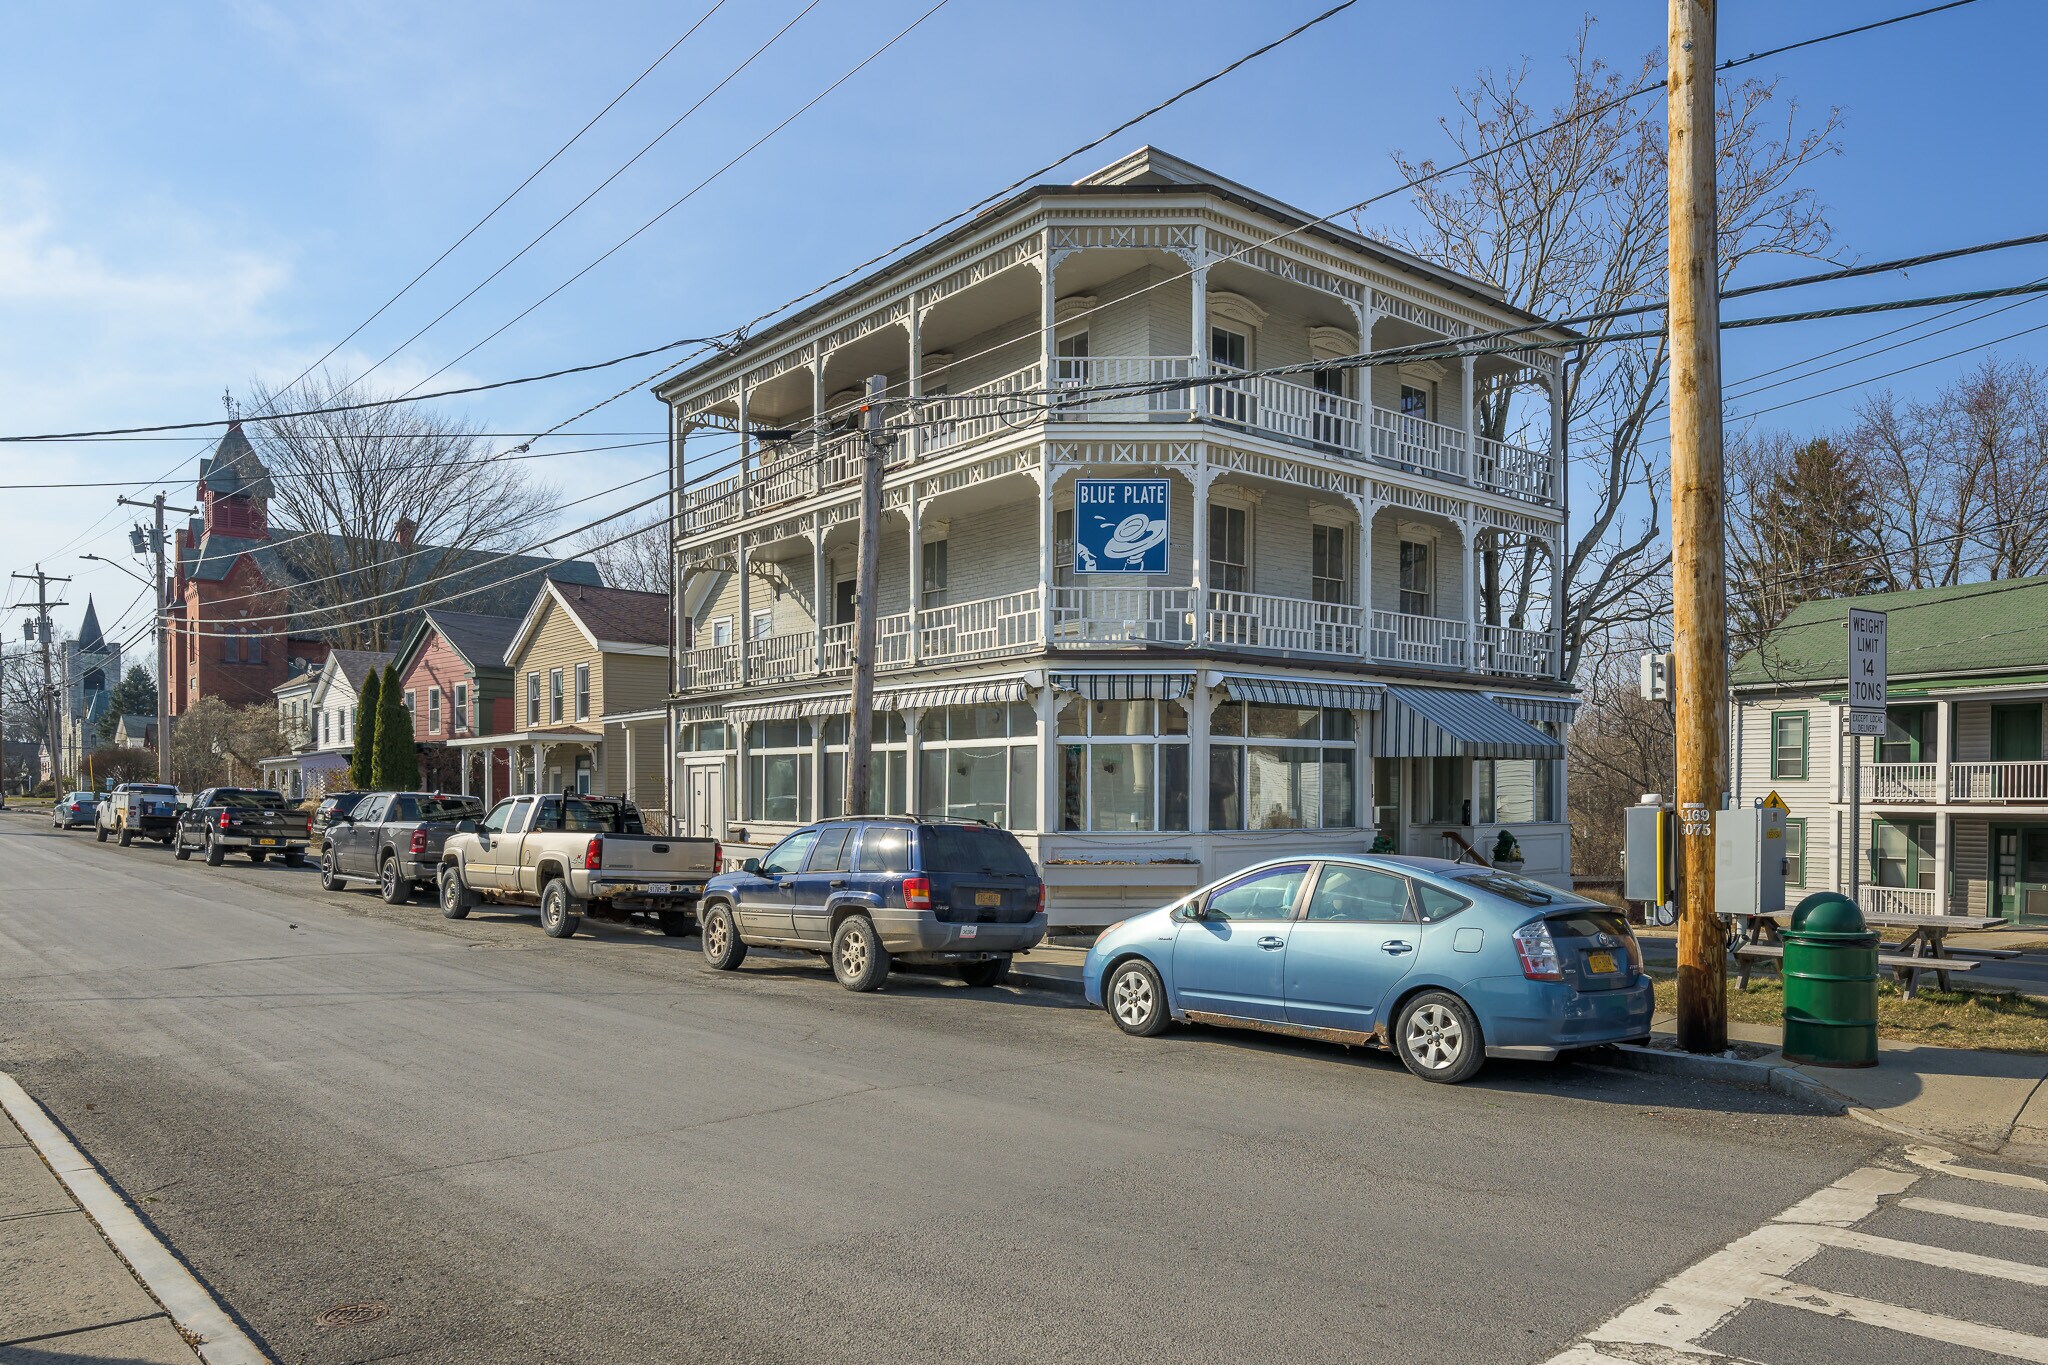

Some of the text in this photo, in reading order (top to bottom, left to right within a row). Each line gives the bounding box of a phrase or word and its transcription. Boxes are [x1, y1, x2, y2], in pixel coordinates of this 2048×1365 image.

[1081, 485, 1164, 504] BLUE PLATE
[1853, 617, 1884, 635] WEIGHT
[1857, 637, 1879, 653] LIMIT
[1862, 658, 1874, 677] 14
[1854, 681, 1882, 701] TONS
[1852, 713, 1868, 722] EXCEPT
[1857, 724, 1877, 733] DELIVERY
